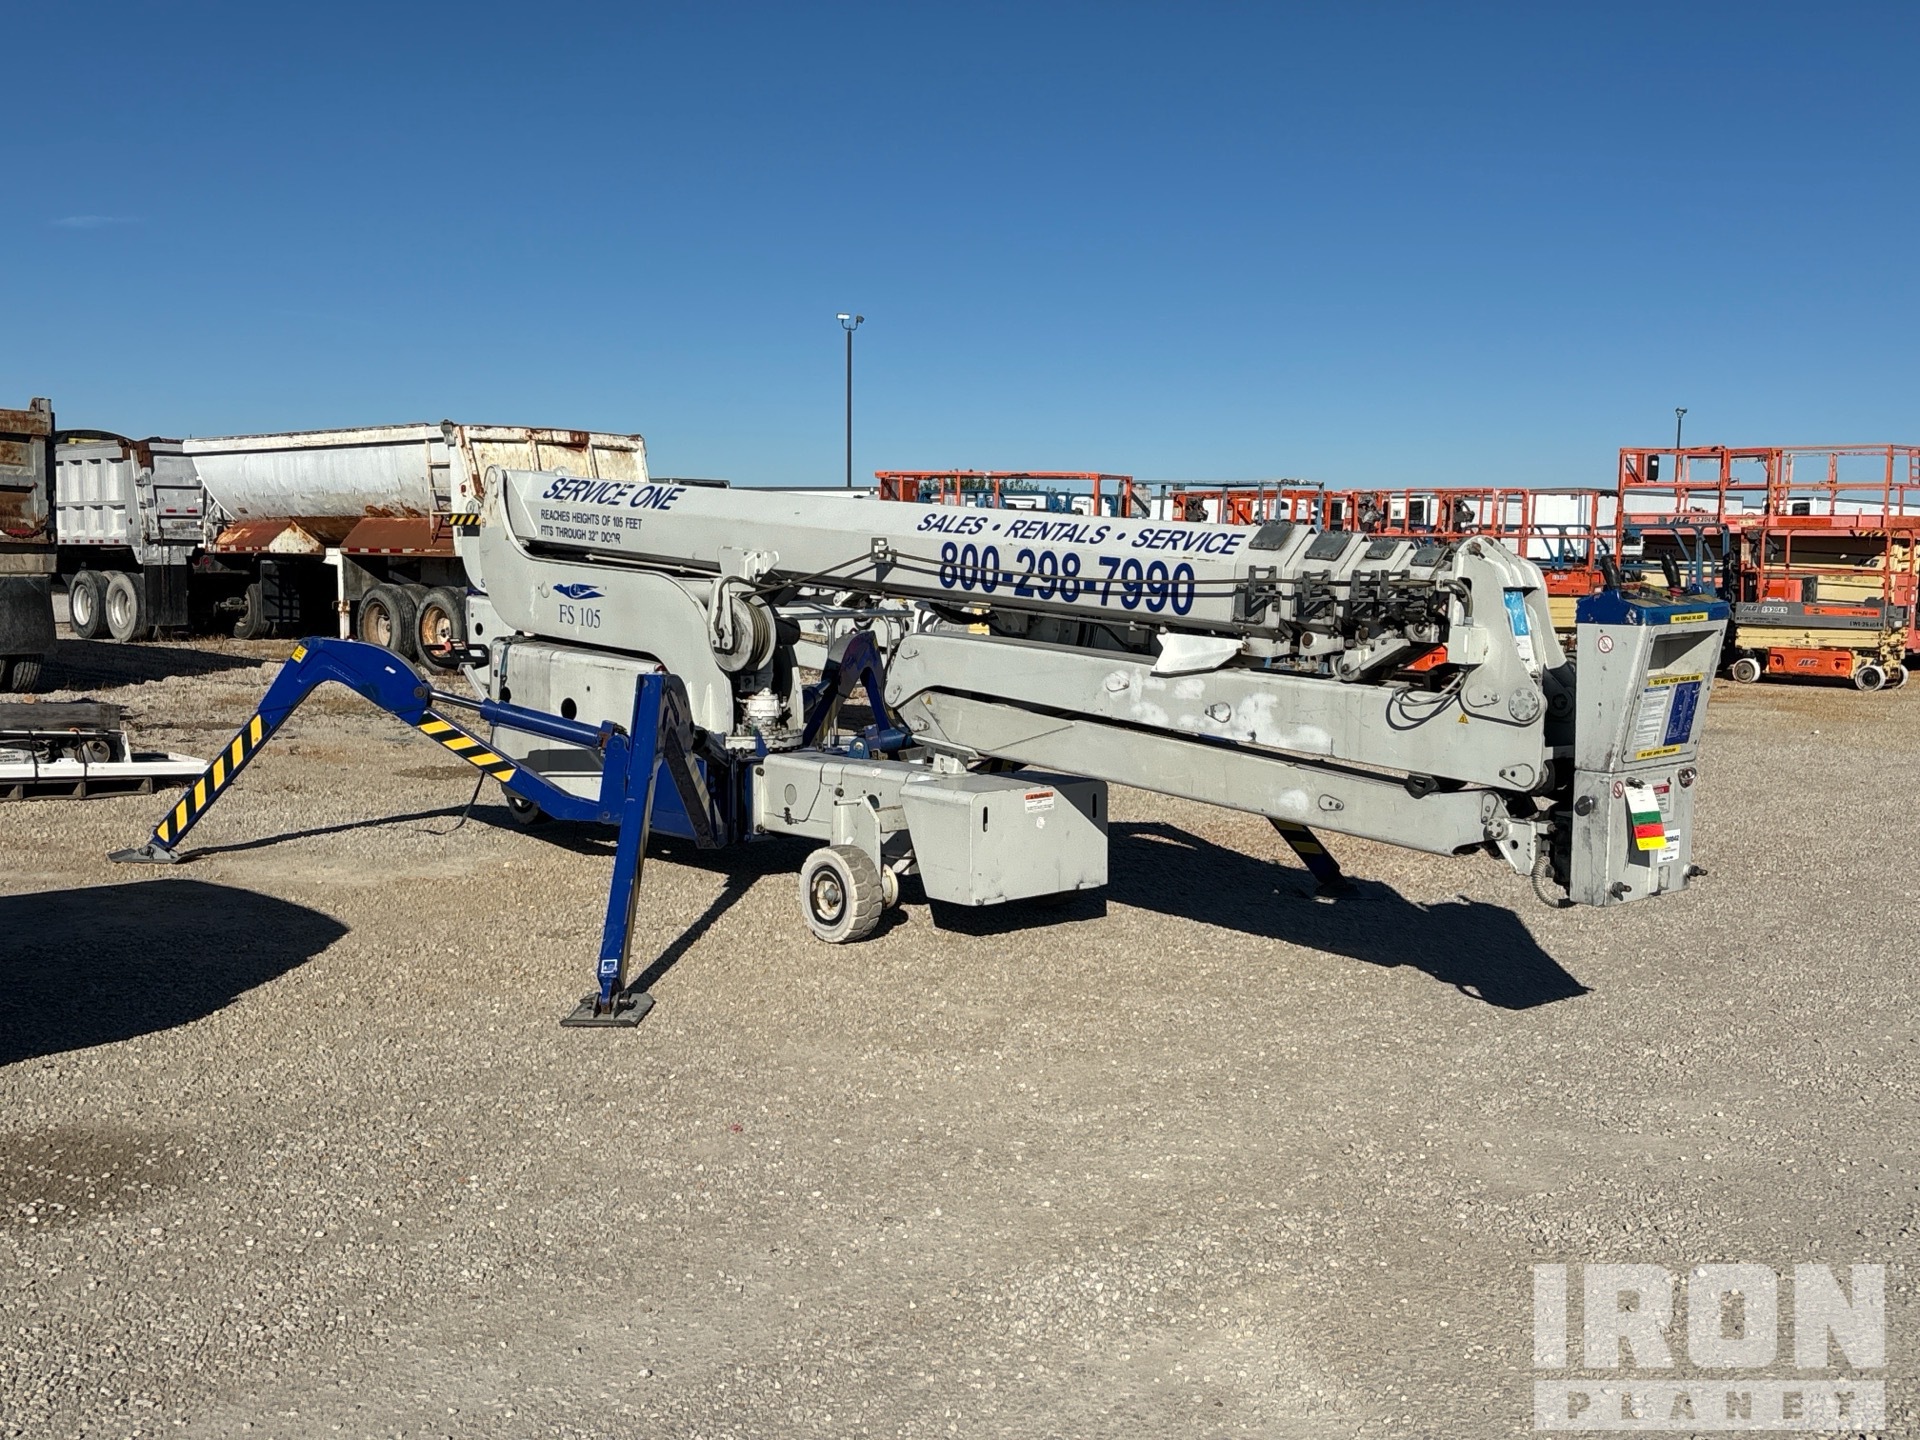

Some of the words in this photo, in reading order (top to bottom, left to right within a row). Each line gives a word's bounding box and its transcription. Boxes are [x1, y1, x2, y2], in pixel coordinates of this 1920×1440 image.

[543, 478, 636, 506] SERVICE
[630, 485, 687, 511] ONE
[541, 508, 570, 523] REACHES
[572, 511, 600, 526] HEIGHTS
[602, 514, 611, 527] OF
[613, 517, 623, 529] 105
[625, 517, 643, 530] FEET
[1669, 516, 1691, 525] JLG
[541, 525, 553, 537] FITS
[555, 526, 587, 541] THROUGH
[588, 529, 598, 541] 32"
[917, 513, 988, 535] SALES
[1004, 519, 1111, 544] RENTALS
[1131, 528, 1246, 555] SERVICE
[939, 541, 1195, 616] 800-298-7990
[559, 603, 575, 625] FS
[580, 607, 601, 629] 105
[1798, 659, 1818, 667] JLG
